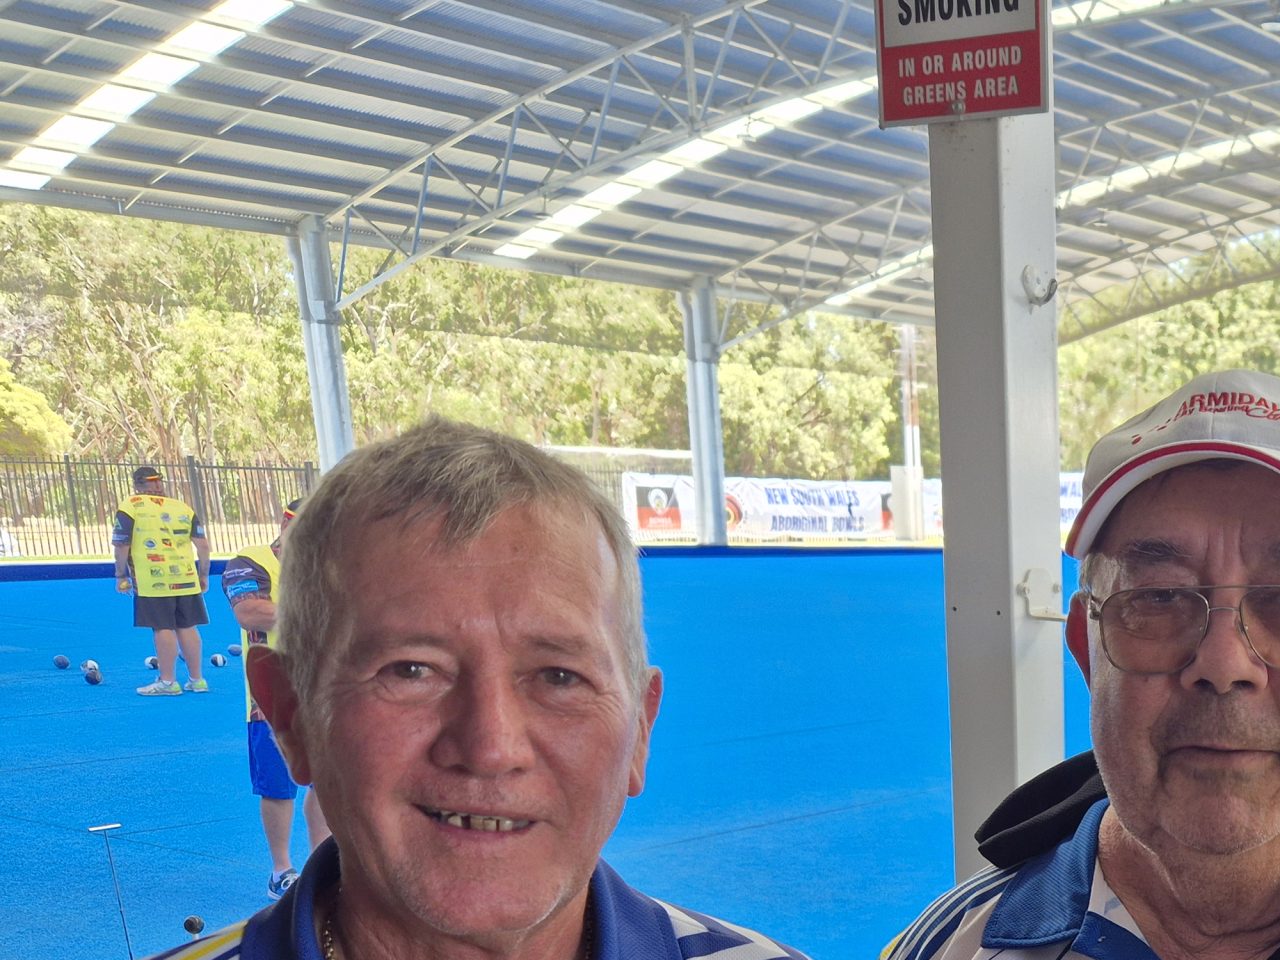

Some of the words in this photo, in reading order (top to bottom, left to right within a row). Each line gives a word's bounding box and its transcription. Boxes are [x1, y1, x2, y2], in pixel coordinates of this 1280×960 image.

[898, 57, 916, 78] IN
[921, 54, 945, 76] OR
[951, 45, 1023, 73] AROUND
[903, 80, 967, 106] GREENS
[974, 75, 1019, 99] AREA
[764, 487, 788, 505] NEW
[790, 487, 825, 506] SOUTH
[826, 489, 861, 507] WALES
[770, 515, 828, 532] ABORIGINAL
[831, 516, 866, 532] BOWLS
